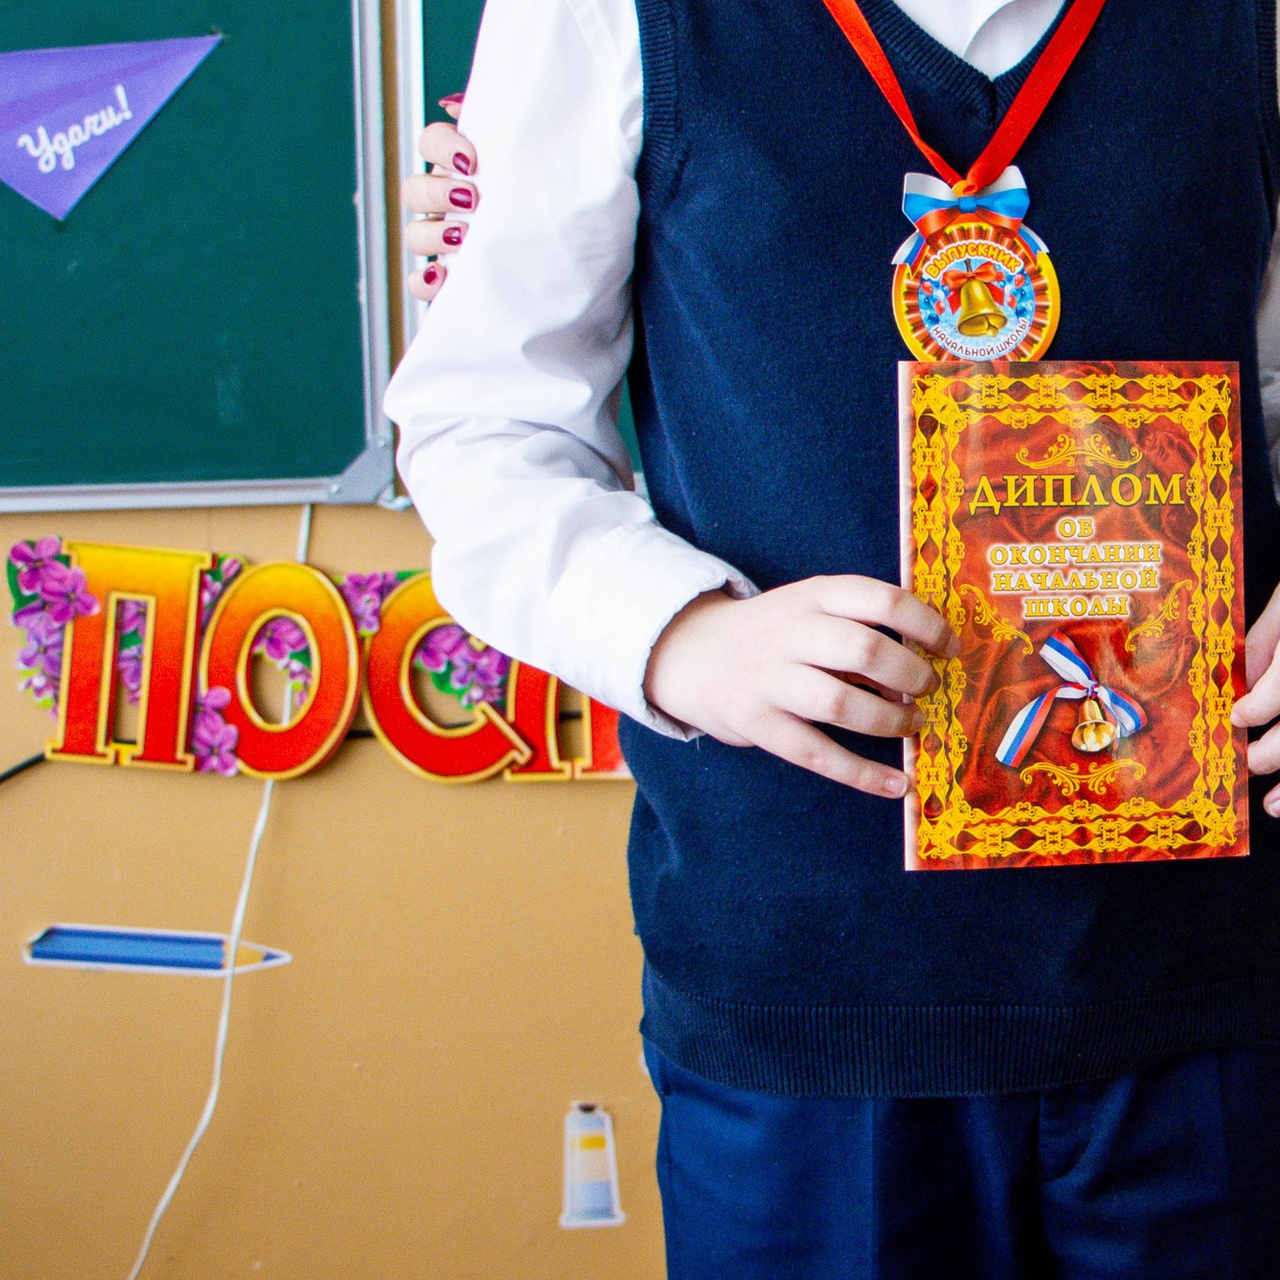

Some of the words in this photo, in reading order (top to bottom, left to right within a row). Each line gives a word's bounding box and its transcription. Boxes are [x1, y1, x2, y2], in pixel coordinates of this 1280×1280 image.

[17, 83, 133, 174] Удачи!
[925, 242, 1022, 279] ВЫПУСКНИК
[932, 326, 995, 357] НАЧАЛЬНОЙ
[998, 319, 1028, 353] ШКОЛЫ
[968, 472, 1185, 515] ДИПЛОМ
[1058, 519, 1094, 539] ОБ
[989, 544, 1162, 566] ОКОНЧАНИИ
[993, 567, 1159, 593] НАЧАЛЬНОЙ
[1025, 598, 1128, 618] ШКОЛЫ
